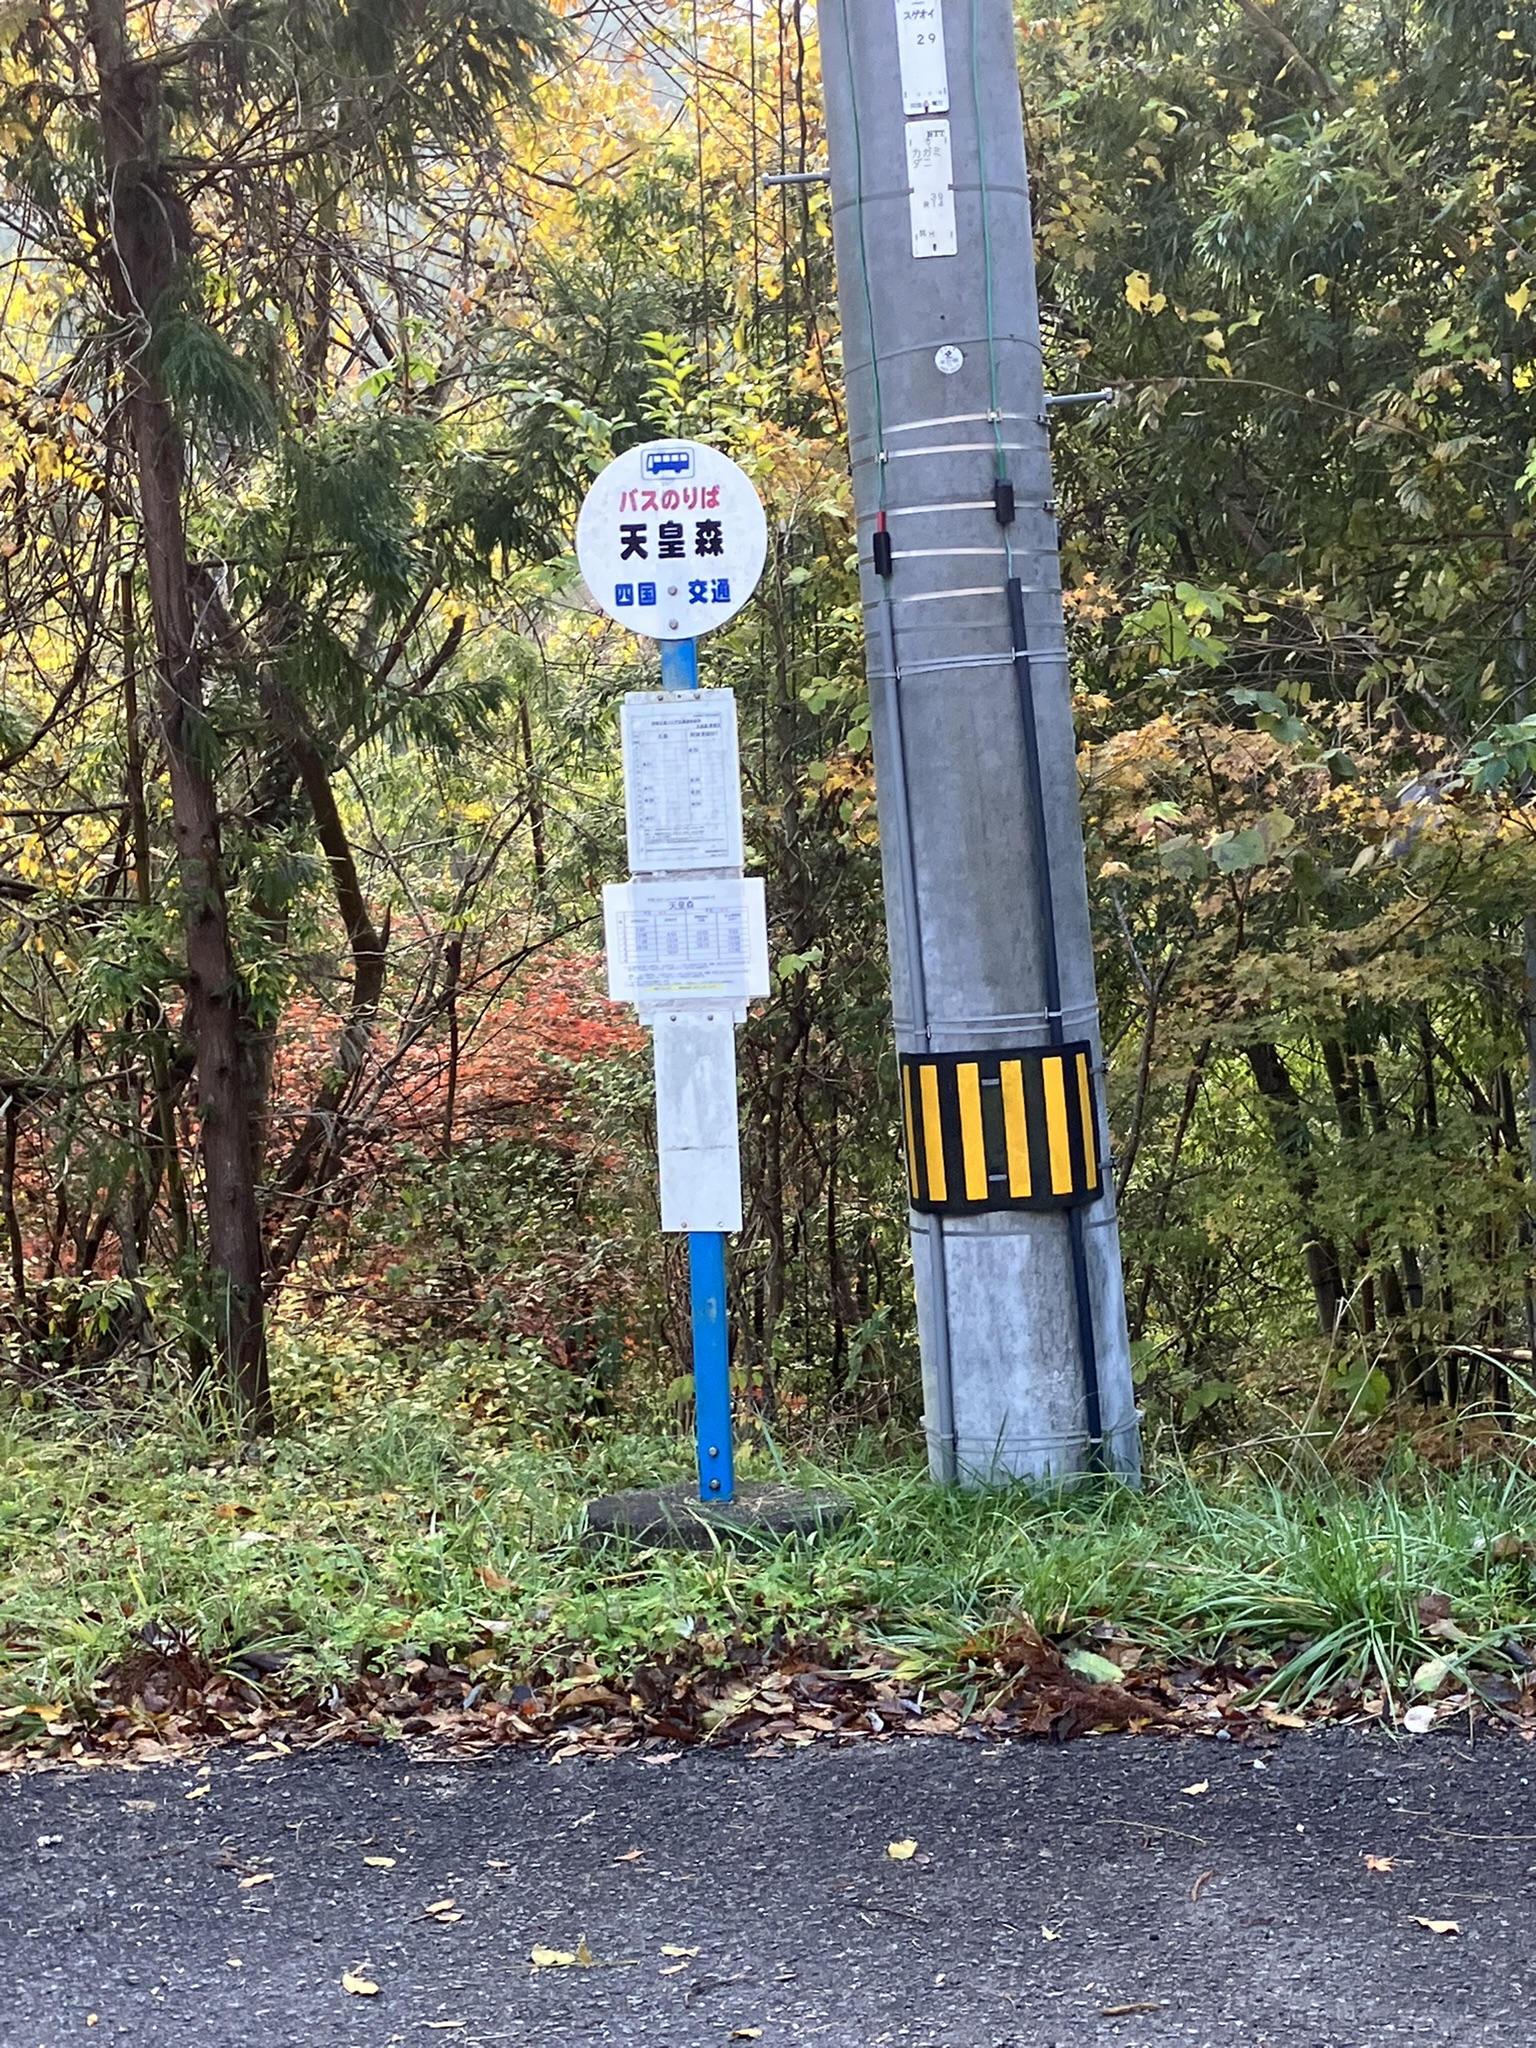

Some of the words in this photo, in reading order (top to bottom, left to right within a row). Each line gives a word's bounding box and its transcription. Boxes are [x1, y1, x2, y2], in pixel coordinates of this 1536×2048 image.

[917, 33, 937, 45] 29
[619, 484, 720, 512] バスのりば
[619, 518, 724, 560] 天皇森
[615, 582, 657, 606] 四国
[688, 579, 731, 604] 交通
